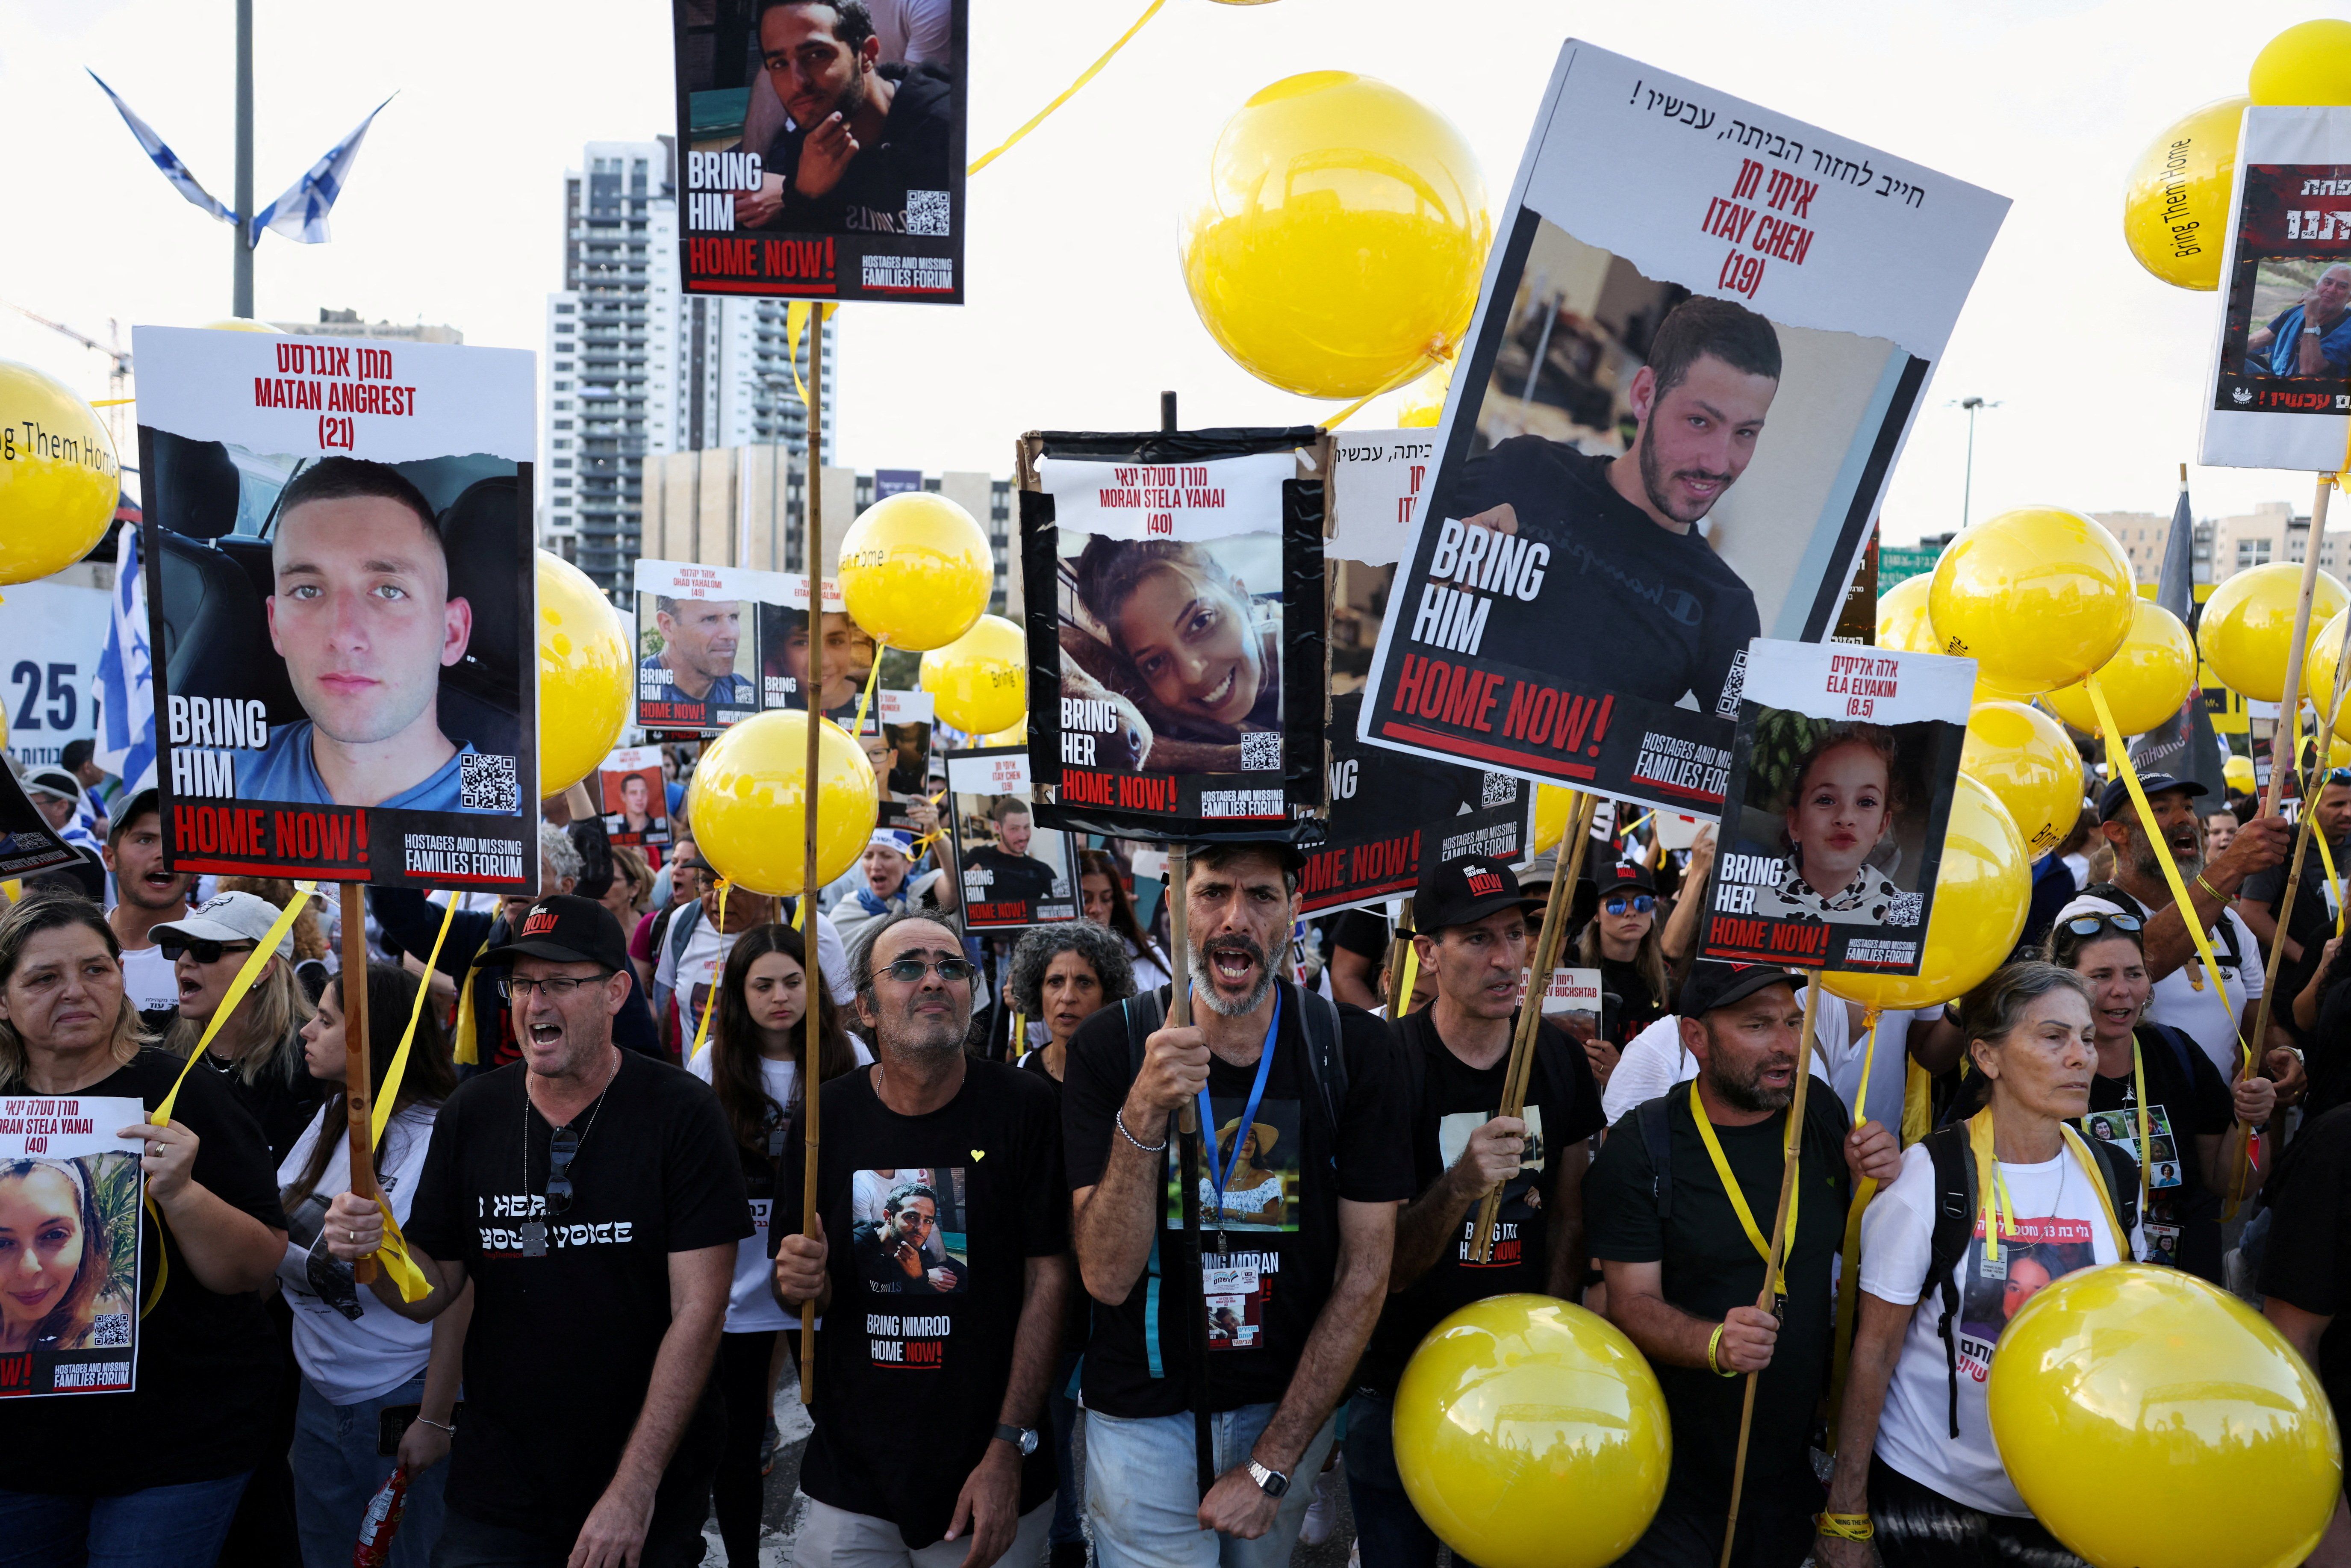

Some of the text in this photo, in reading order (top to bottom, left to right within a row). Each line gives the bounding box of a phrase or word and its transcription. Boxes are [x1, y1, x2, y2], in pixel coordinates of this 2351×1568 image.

[1647, 88, 1715, 131] עכשיו
[688, 150, 763, 192] BRING
[1812, 148, 1873, 188] לחזור
[1731, 157, 1819, 219] איתי חן
[1876, 175, 1925, 209] חייב
[2161, 139, 2200, 257] Bring Them Home
[688, 192, 735, 232] HIM
[1701, 196, 1815, 266] ITAY CHEN
[689, 236, 835, 279] HOME NOW!
[862, 255, 952, 271] HOSTAGES AND MISSING
[862, 268, 952, 289] FAMILIES FORUM
[1718, 248, 1766, 299] (19)
[276, 343, 392, 381] מתן אנגרסט
[255, 377, 416, 416] MATAN ANGREST
[2271, 392, 2330, 410] עכשיו
[318, 415, 354, 451] (21)
[22, 421, 78, 463] Them
[83, 435, 115, 479] Home
[1115, 466, 1207, 489] מורן סטלה ינאי
[1100, 488, 1225, 509] MORAN STELA YANAI
[1147, 513, 1173, 535] (40)
[1429, 516, 1550, 601] BRING
[673, 577, 722, 589] OHAD YAHALOMI
[691, 589, 704, 598] (49)
[1411, 582, 1492, 657] HIM
[641, 668, 674, 685] BRING
[1830, 654, 1898, 678] אלה אליקים
[764, 676, 797, 693] BRING
[991, 667, 1016, 689] Bring
[1826, 675, 1897, 699] ELA ELYAKIM
[640, 684, 662, 701] HIM
[765, 692, 786, 708] HIM
[640, 702, 706, 720] HOME NOW!
[1061, 697, 1117, 734] BRING
[1393, 652, 1616, 758] HOME NOW!
[1846, 697, 1874, 719] (8.5)
[171, 695, 268, 749] BRING
[1061, 731, 1096, 766] HER
[1641, 731, 1716, 764] HOSTAGES AND
[171, 748, 233, 799] HIM
[992, 771, 1021, 781] ITAY CHEN
[1633, 750, 1729, 797] FAMILIES FOR
[1062, 769, 1178, 812] HOME NOW!
[1201, 789, 1284, 803] HOSTAGES AND MISSING
[1201, 801, 1284, 817] FAMILIES FORUM
[174, 805, 371, 864] HOME NOW!
[404, 833, 522, 856] HOSTAGES AND MISSING
[1443, 821, 1517, 852] HOSTAGES AND MISSING
[1484, 834, 1517, 856] FORUM
[1, 852, 69, 871] FAMILIES FORUM
[405, 849, 522, 878] FAMILIES FORUM
[1352, 829, 1421, 885] NOW!
[963, 869, 994, 887] BRING
[1463, 865, 1476, 873] BRING
[1465, 870, 1477, 878] THEM
[1720, 853, 1784, 887] BRING
[965, 885, 986, 902] HIM
[1467, 873, 1503, 893] NOW
[967, 899, 1028, 920] HOME NOW!
[1715, 883, 1756, 915] HER
[522, 913, 560, 933] NOW
[1709, 916, 1831, 955] HOME NOW!
[1849, 938, 1917, 952] HOSTAGES AND MISSING
[1846, 947, 1916, 964] FAMILIES FORUM
[1556, 974, 1574, 986] רימון
[1555, 987, 1597, 998] BUCHSHTAB
[5, 1099, 79, 1117] מורן סטלה ינאי
[26, 1118, 93, 1135] STELA YANAI
[24, 1136, 48, 1155] (40)
[479, 1194, 547, 1217] I HEA
[553, 1221, 633, 1248] VOICE
[2058, 1226, 2074, 1237] בת
[2076, 1224, 2090, 1238] גלי
[1494, 1240, 1521, 1261] NOW!
[1230, 1252, 1279, 1274] MORAN
[867, 1313, 951, 1337] BRING NIMROD
[871, 1339, 943, 1364] HOME NOW!
[54, 1362, 130, 1374] HOSTAGES AND MISSING
[54, 1371, 129, 1388] FAMILIES FORUM
